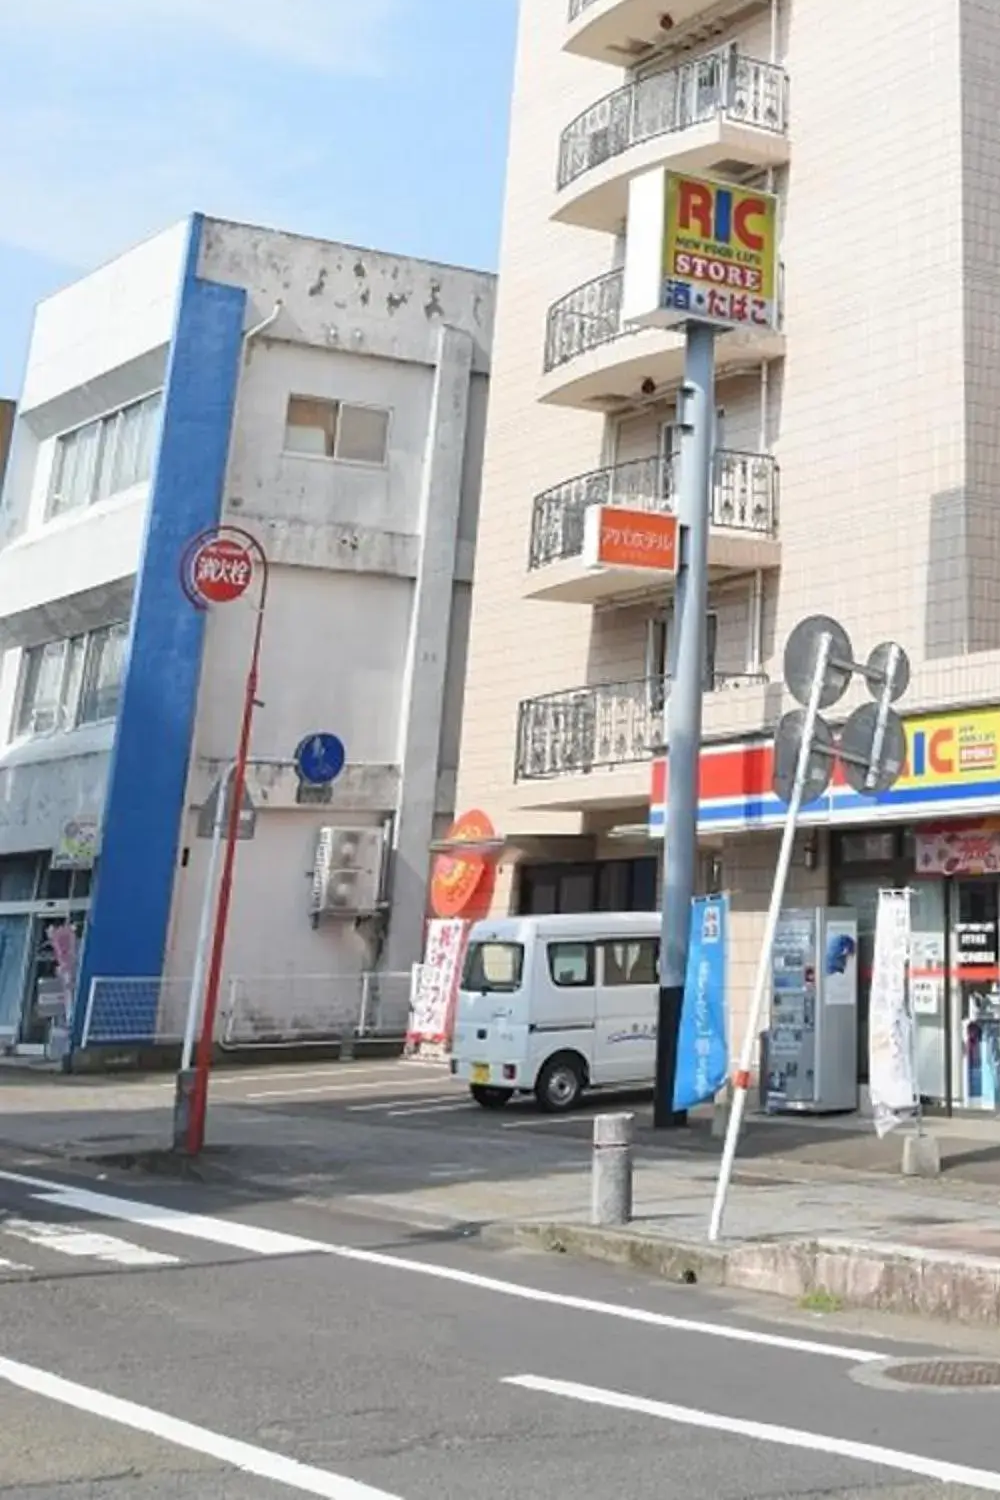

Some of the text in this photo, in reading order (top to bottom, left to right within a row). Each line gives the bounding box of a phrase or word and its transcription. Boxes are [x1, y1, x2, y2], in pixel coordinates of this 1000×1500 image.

[678, 179, 766, 251] RIC
[675, 253, 762, 291] STORE
[197, 557, 250, 585] 消火栓
[903, 728, 955, 778] IC
